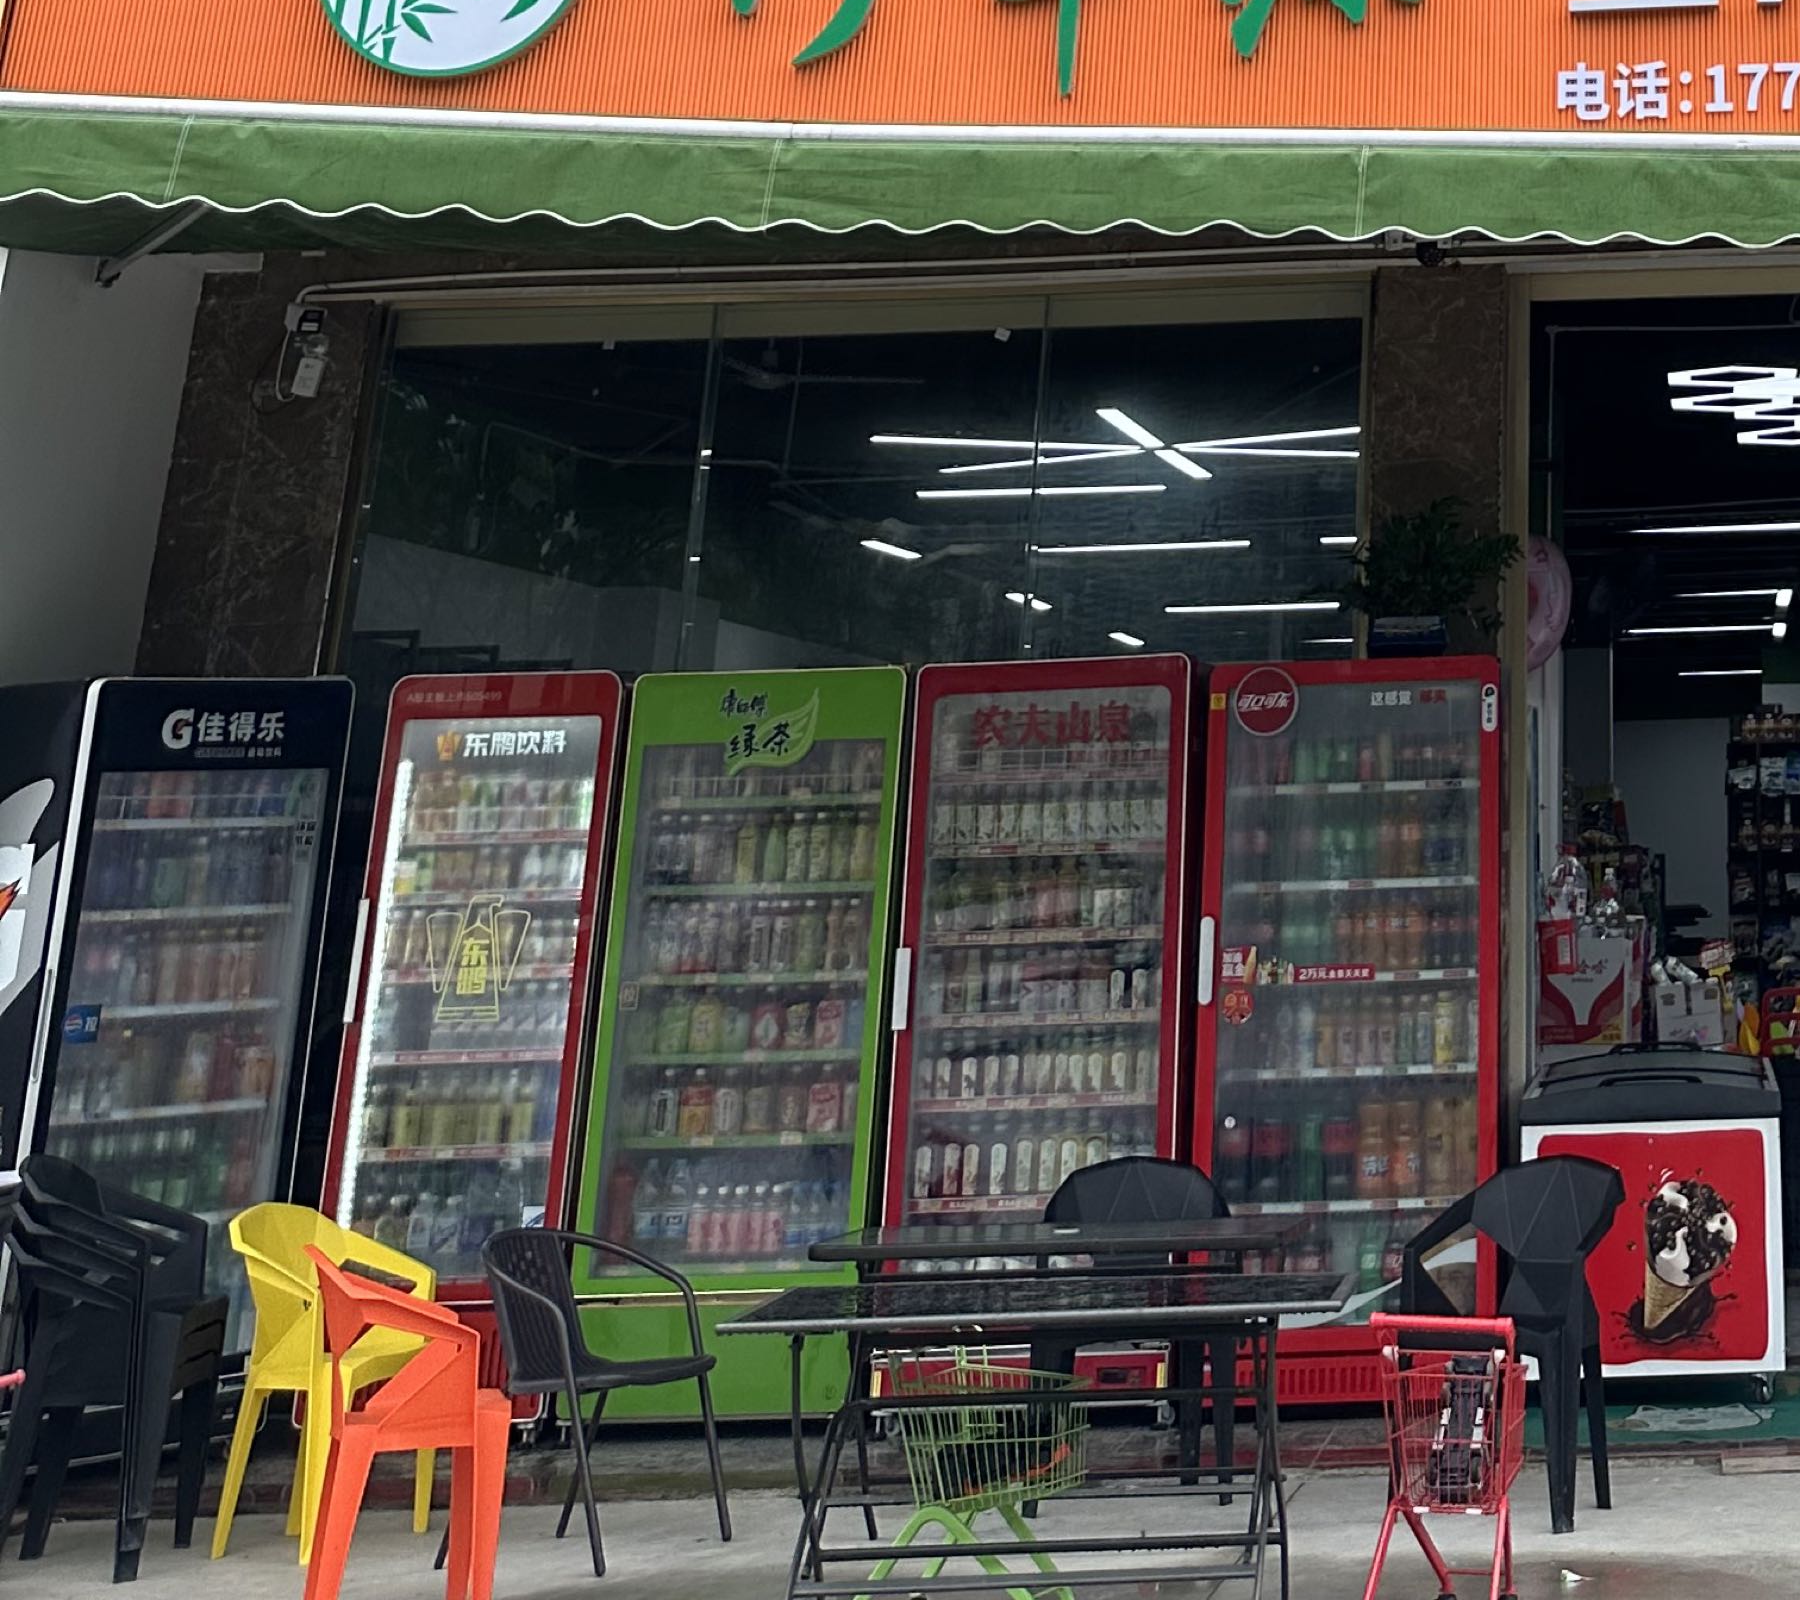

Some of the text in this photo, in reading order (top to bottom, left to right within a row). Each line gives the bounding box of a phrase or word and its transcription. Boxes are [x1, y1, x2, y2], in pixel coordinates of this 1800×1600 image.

[720, 687, 770, 719] 康师傅
[1238, 689, 1292, 712] 可口可乐
[196, 711, 285, 742] 佳得乐
[972, 701, 1132, 748] 农夫山泉
[462, 730, 567, 758] 东鹏饮料
[727, 721, 791, 760] 绿茶
